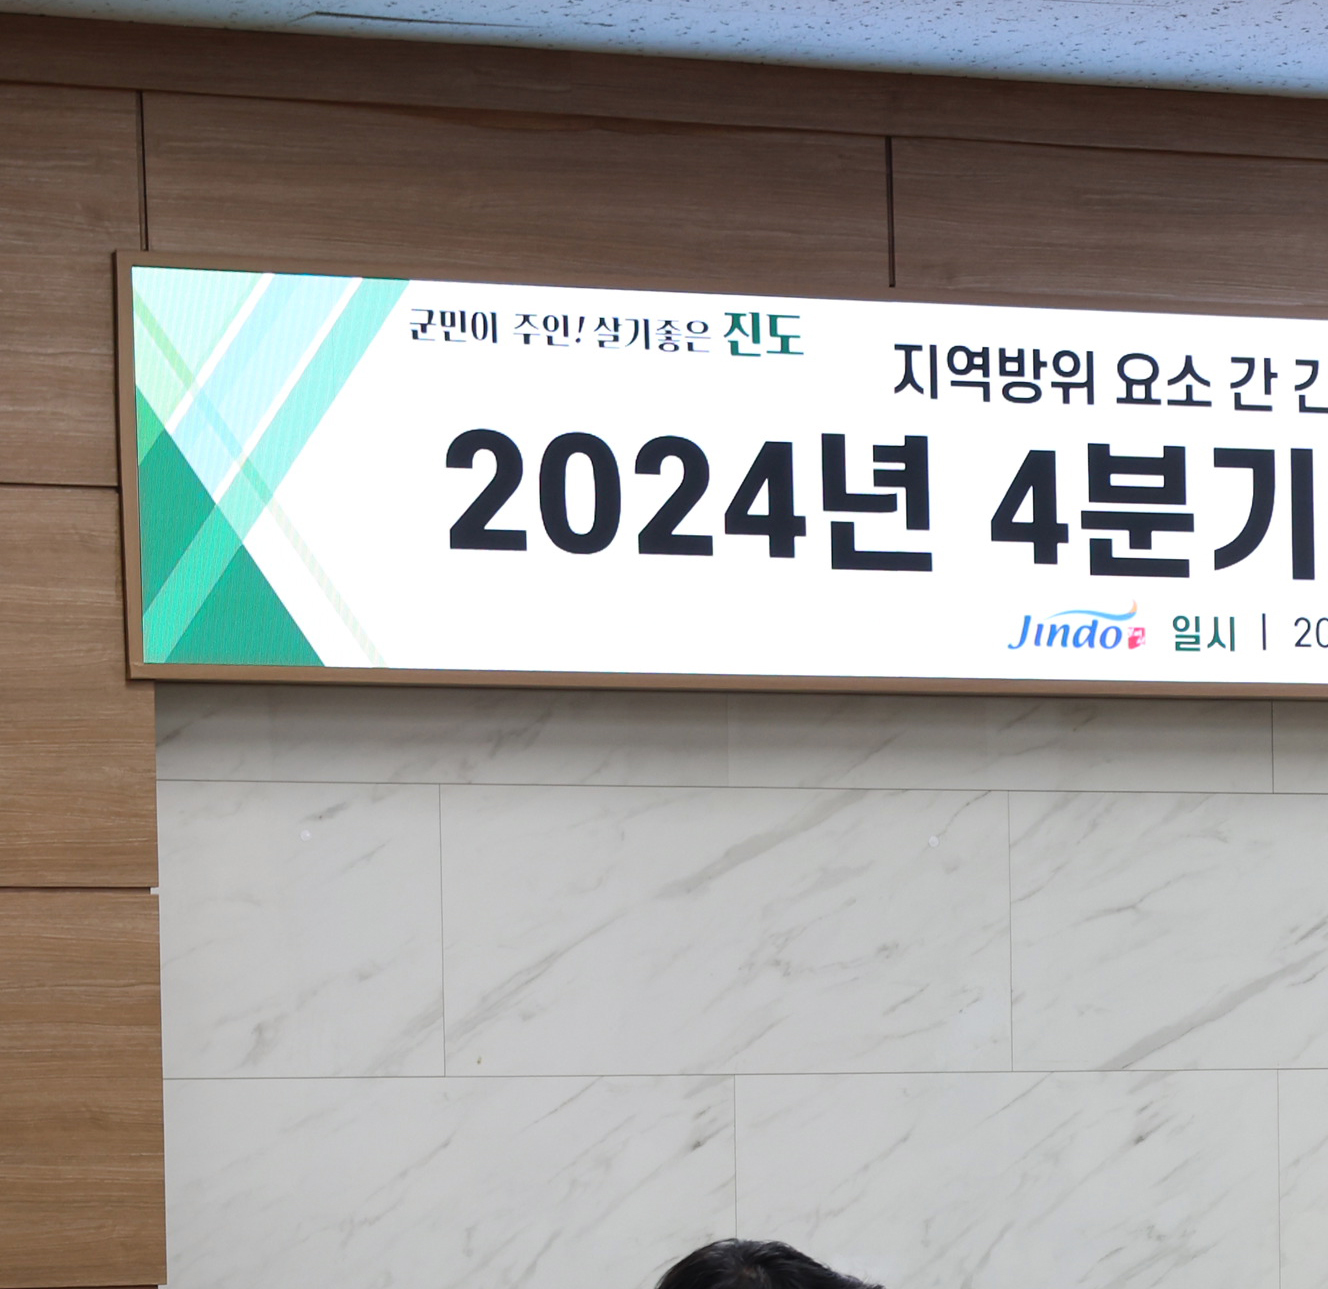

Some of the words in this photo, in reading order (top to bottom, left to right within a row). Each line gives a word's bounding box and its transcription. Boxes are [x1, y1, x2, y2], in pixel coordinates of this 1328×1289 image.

[409, 308, 498, 344] 군민이
[514, 313, 586, 347] 주인!
[593, 316, 709, 353] 살기좋은
[723, 311, 805, 358] 진도
[893, 343, 1095, 406] 지역방위
[1116, 352, 1213, 408] 요소
[1229, 356, 1279, 412] 간
[445, 427, 933, 573] 2024년
[990, 442, 1316, 581] 4분기
[1008, 615, 1123, 650] Jindo
[1172, 615, 1236, 652] 일시
